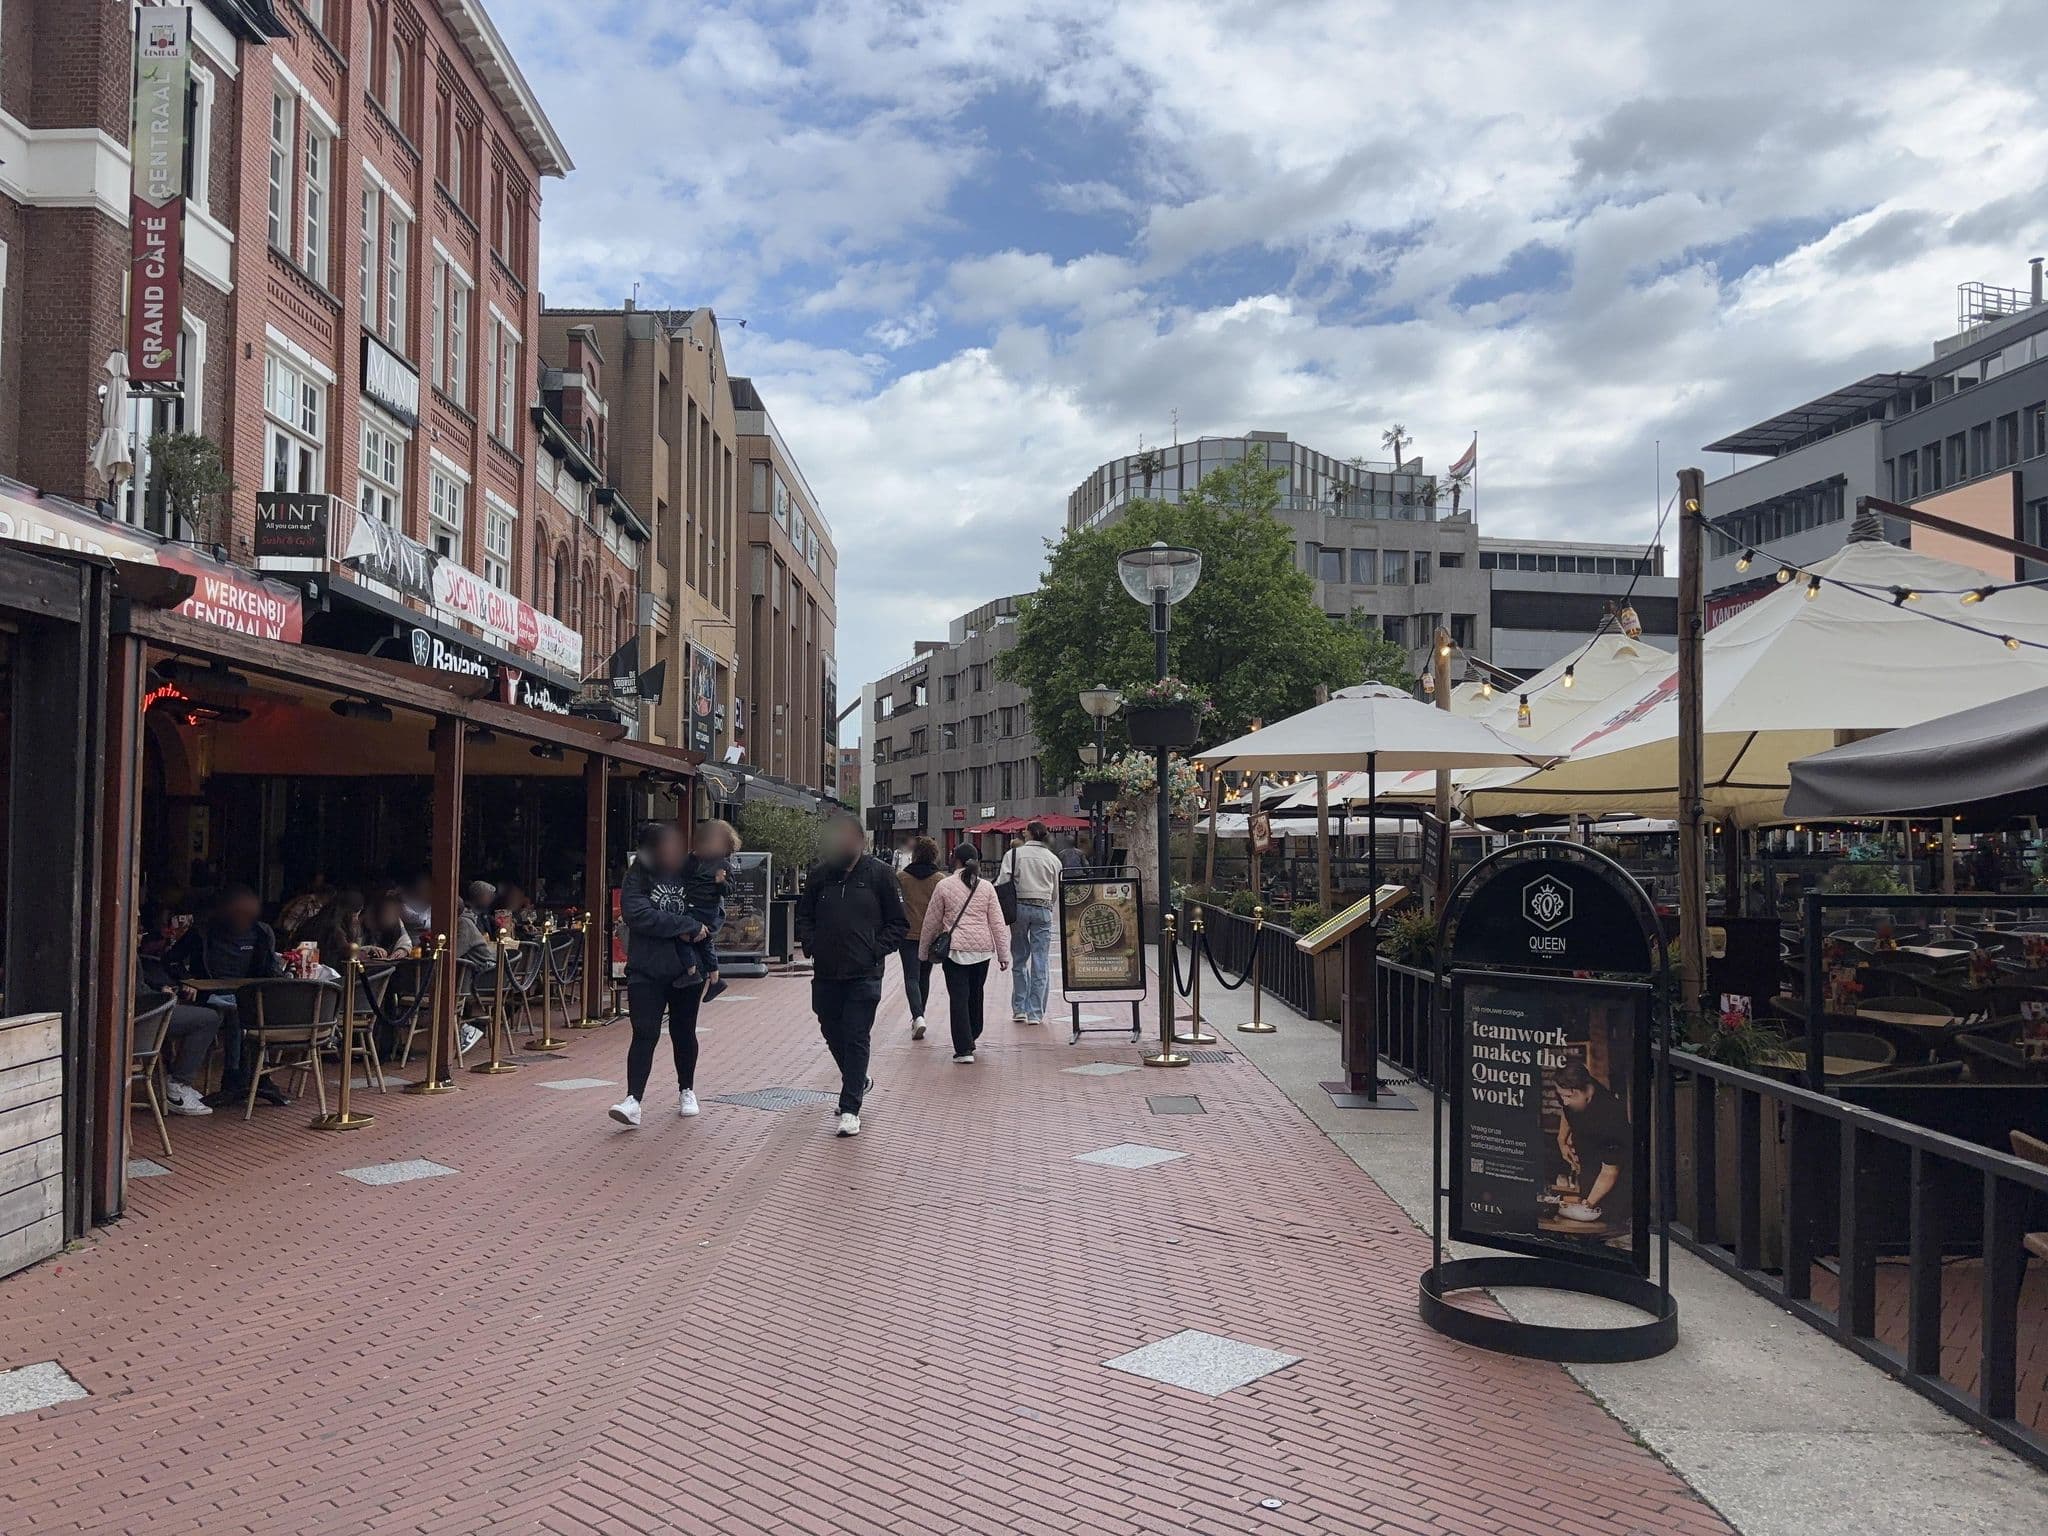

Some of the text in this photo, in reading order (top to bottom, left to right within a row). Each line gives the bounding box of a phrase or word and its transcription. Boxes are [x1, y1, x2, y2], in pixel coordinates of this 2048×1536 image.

[140, 71, 172, 369] GRAND CAFÉ CENTRAAL
[257, 503, 322, 521] MINT
[204, 576, 286, 628] WERKENBIJ
[488, 591, 515, 635] GRILL
[1529, 936, 1566, 950] QUEEN
[1472, 1020, 1569, 1047] teamwork
[1472, 1043, 1567, 1069] makes the
[1471, 1062, 1531, 1087] Queen
[1471, 1087, 1524, 1107] work!
[1470, 1202, 1503, 1214] QUEEN
